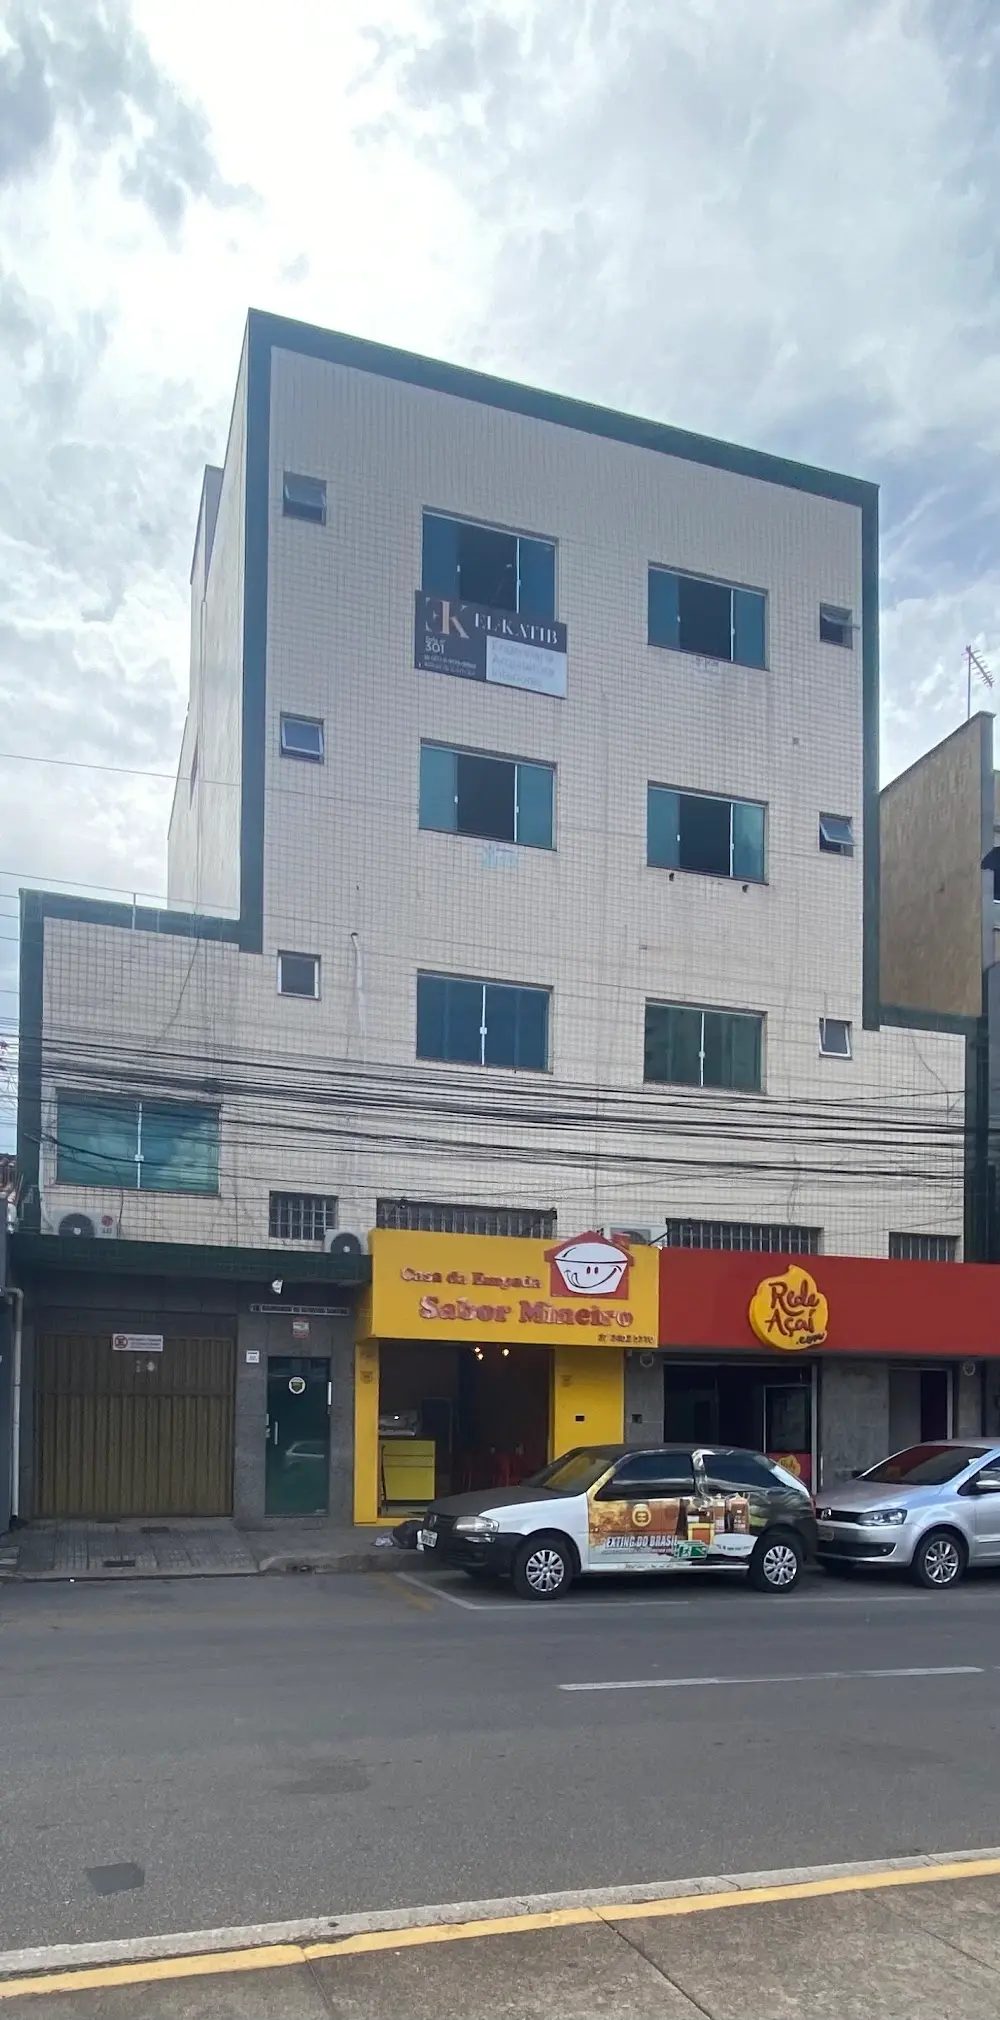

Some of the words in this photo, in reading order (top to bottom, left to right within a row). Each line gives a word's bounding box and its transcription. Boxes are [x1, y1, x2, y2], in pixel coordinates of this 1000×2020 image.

[425, 643, 444, 655] 301
[401, 1267, 442, 1283] Casa
[446, 1271, 468, 1285] da
[768, 1279, 820, 1316] Rede
[419, 1296, 512, 1321] Sabor
[518, 1300, 634, 1327] Mineiro
[765, 1308, 816, 1337] Açaí
[636, 1535, 649, 1547] DO
[649, 1535, 678, 1547] BRASIL
